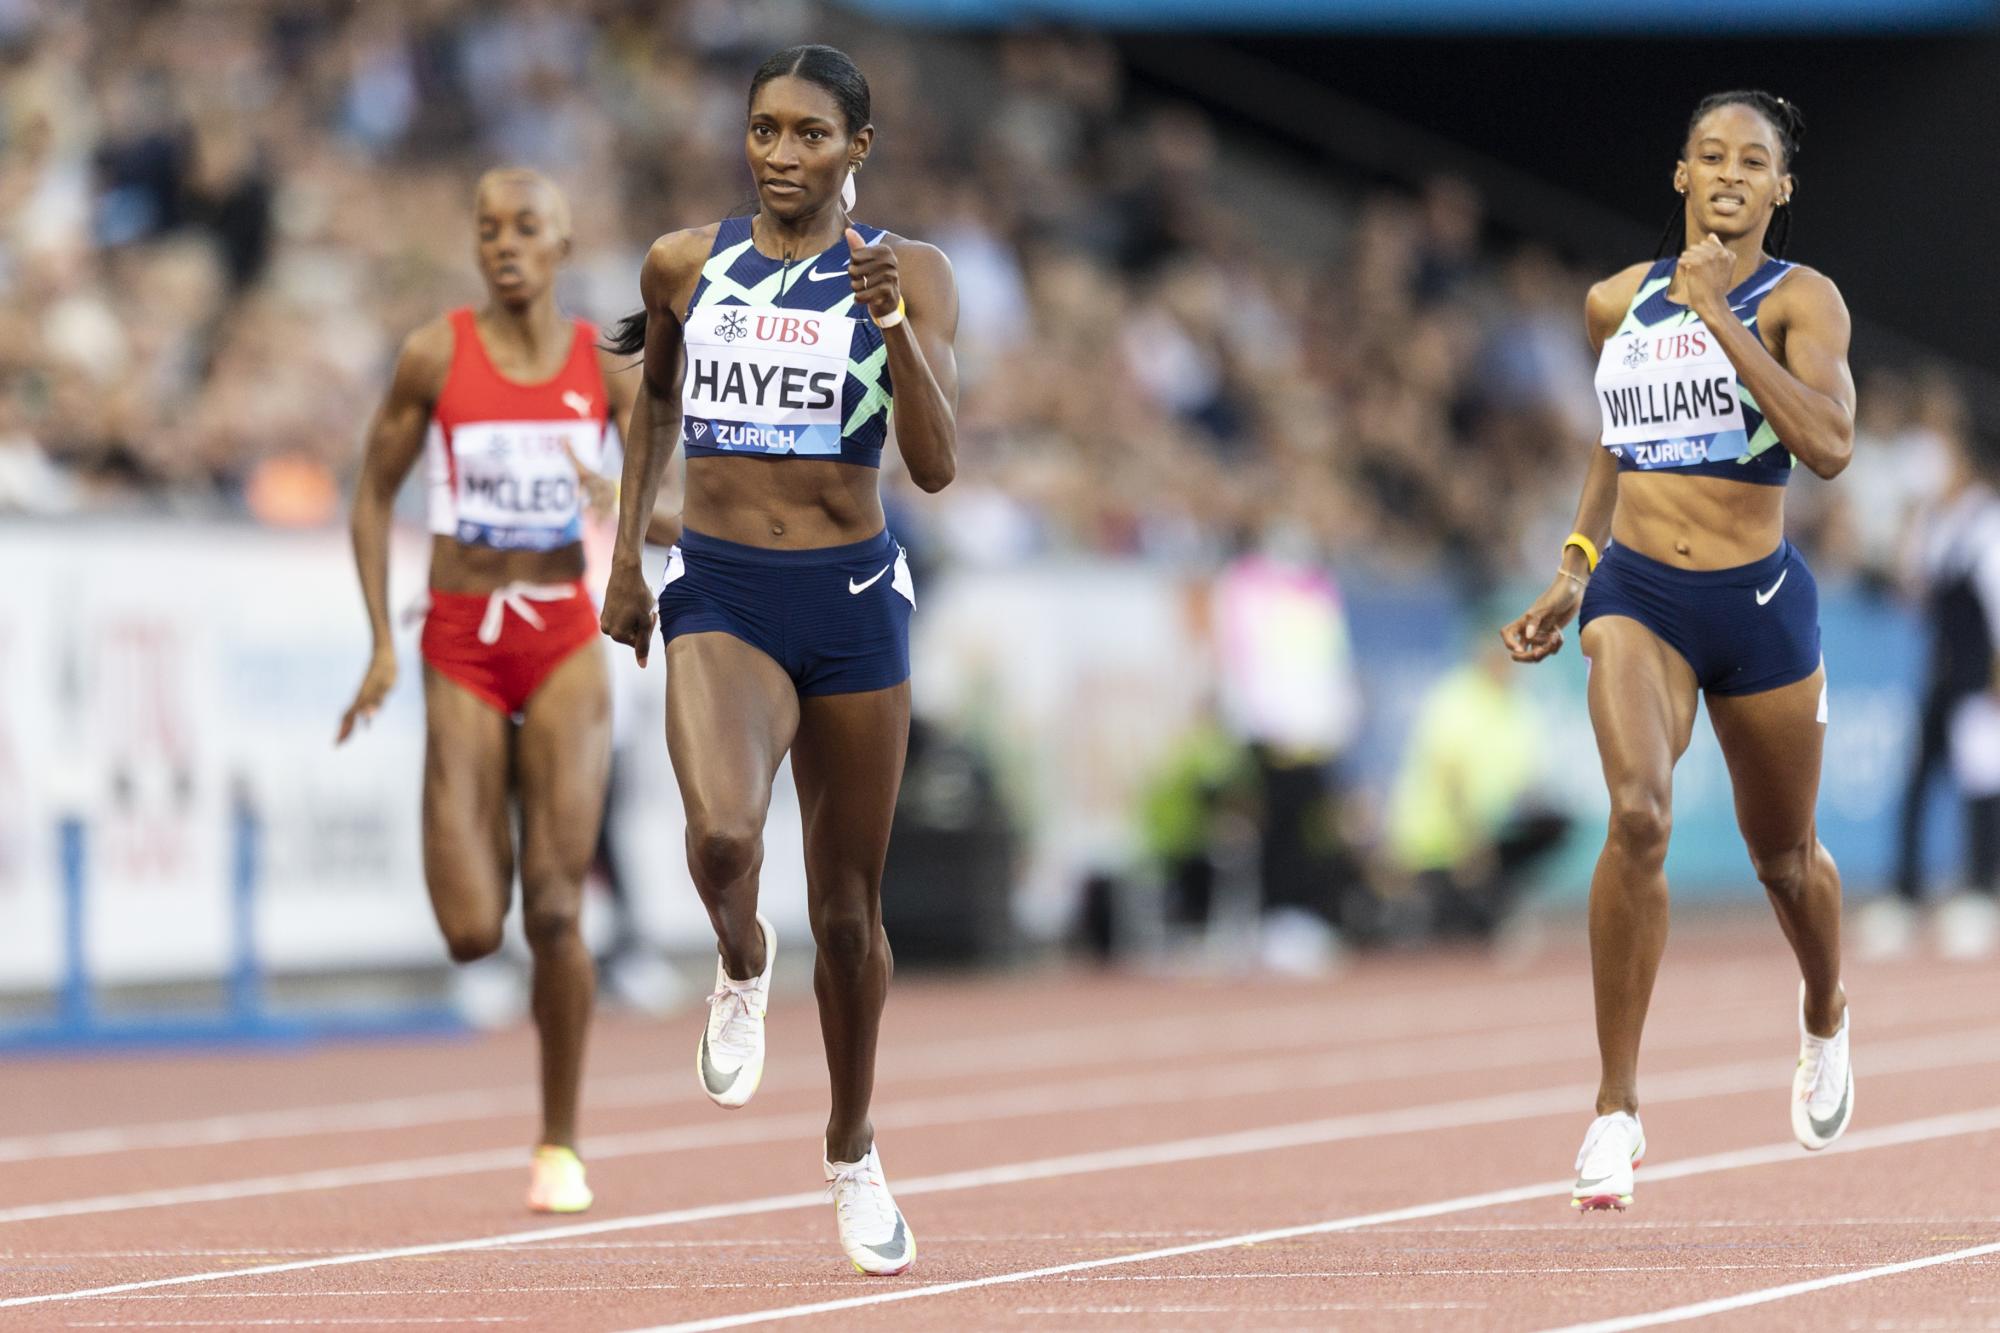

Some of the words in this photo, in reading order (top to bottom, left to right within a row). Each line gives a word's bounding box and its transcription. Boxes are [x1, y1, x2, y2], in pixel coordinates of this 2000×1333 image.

[755, 315, 820, 346] UBS
[1655, 331, 1707, 361] UBS
[691, 359, 837, 410] HAYES
[1603, 377, 1734, 428] WILLIAMS
[716, 425, 795, 449] ZURICH
[1635, 440, 1708, 465] ZURICH
[465, 475, 574, 512] MCLEO
